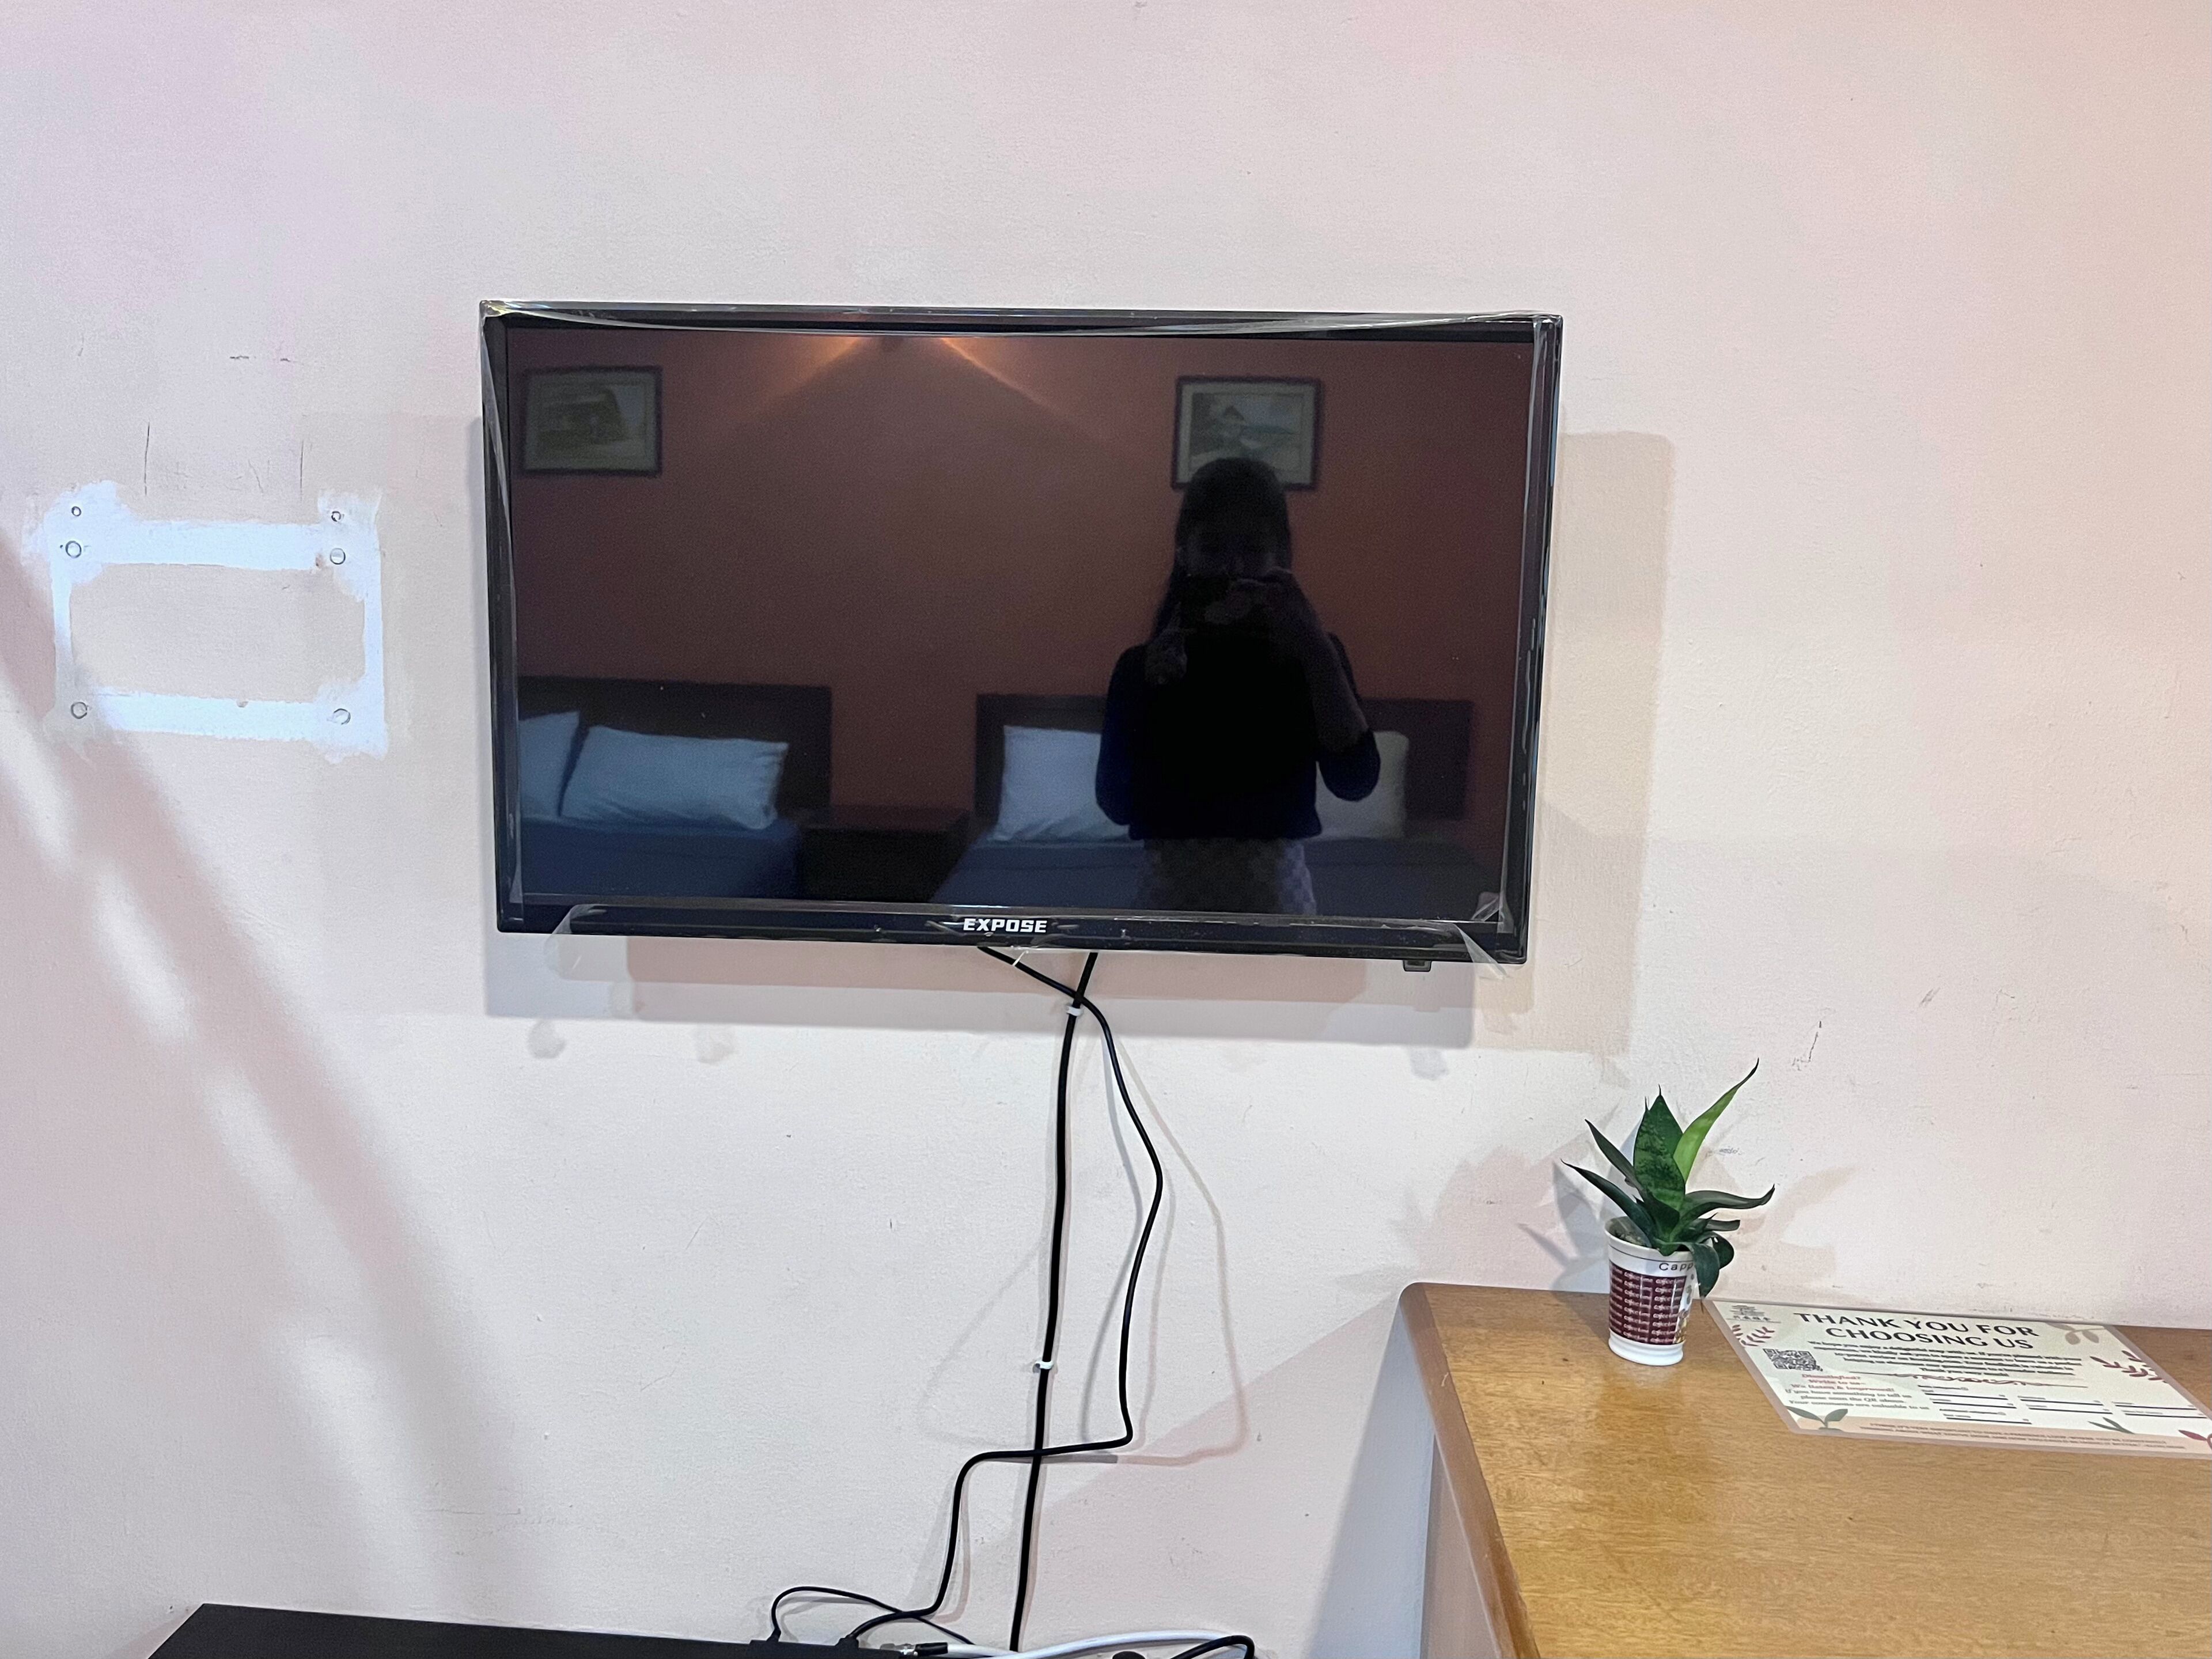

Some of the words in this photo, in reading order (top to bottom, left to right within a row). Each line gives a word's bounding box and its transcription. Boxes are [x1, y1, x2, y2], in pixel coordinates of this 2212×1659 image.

[963, 918, 1047, 933] EXPOSE
[1793, 1313, 1901, 1328] THANK
[1903, 1320, 1969, 1332] YOU
[1976, 1324, 2040, 1336] FOR
[1825, 1328, 1988, 1346] CHOOSING
[1993, 1338, 2033, 1349] US
